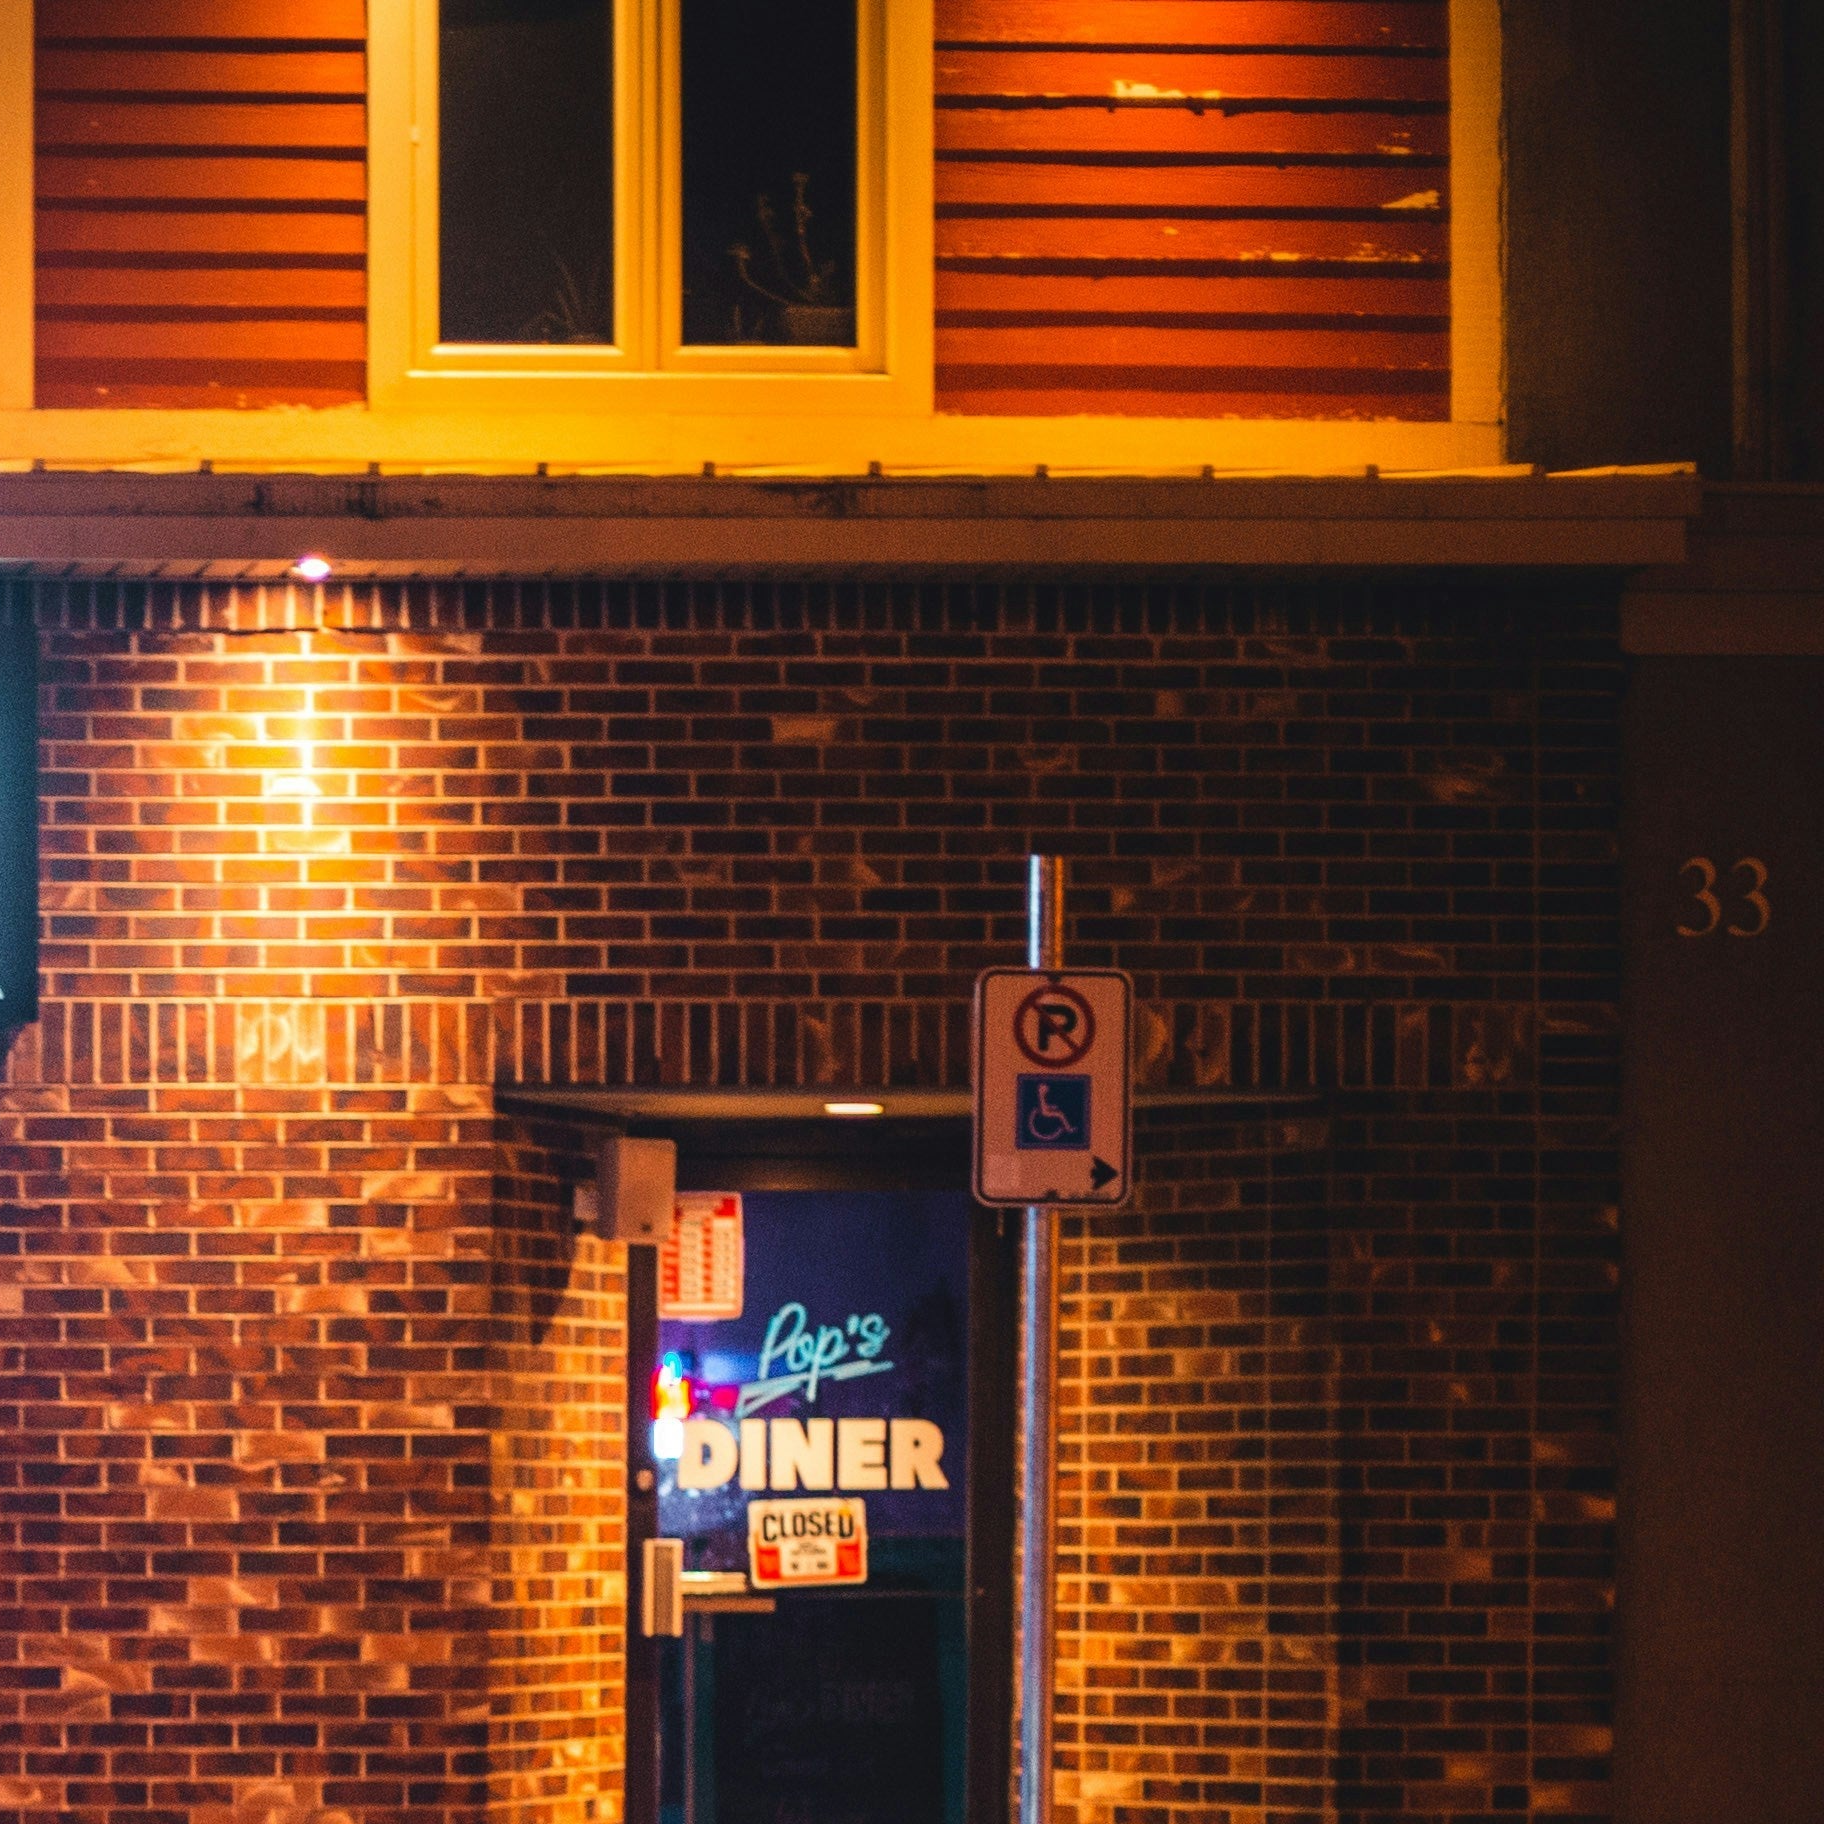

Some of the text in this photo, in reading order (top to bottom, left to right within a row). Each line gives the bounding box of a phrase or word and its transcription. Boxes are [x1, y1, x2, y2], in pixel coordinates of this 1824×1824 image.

[1675, 855, 1772, 939] 33
[757, 1302, 891, 1403] Pop's
[675, 1416, 950, 1492] DINER
[762, 1510, 854, 1542] CLOSED
